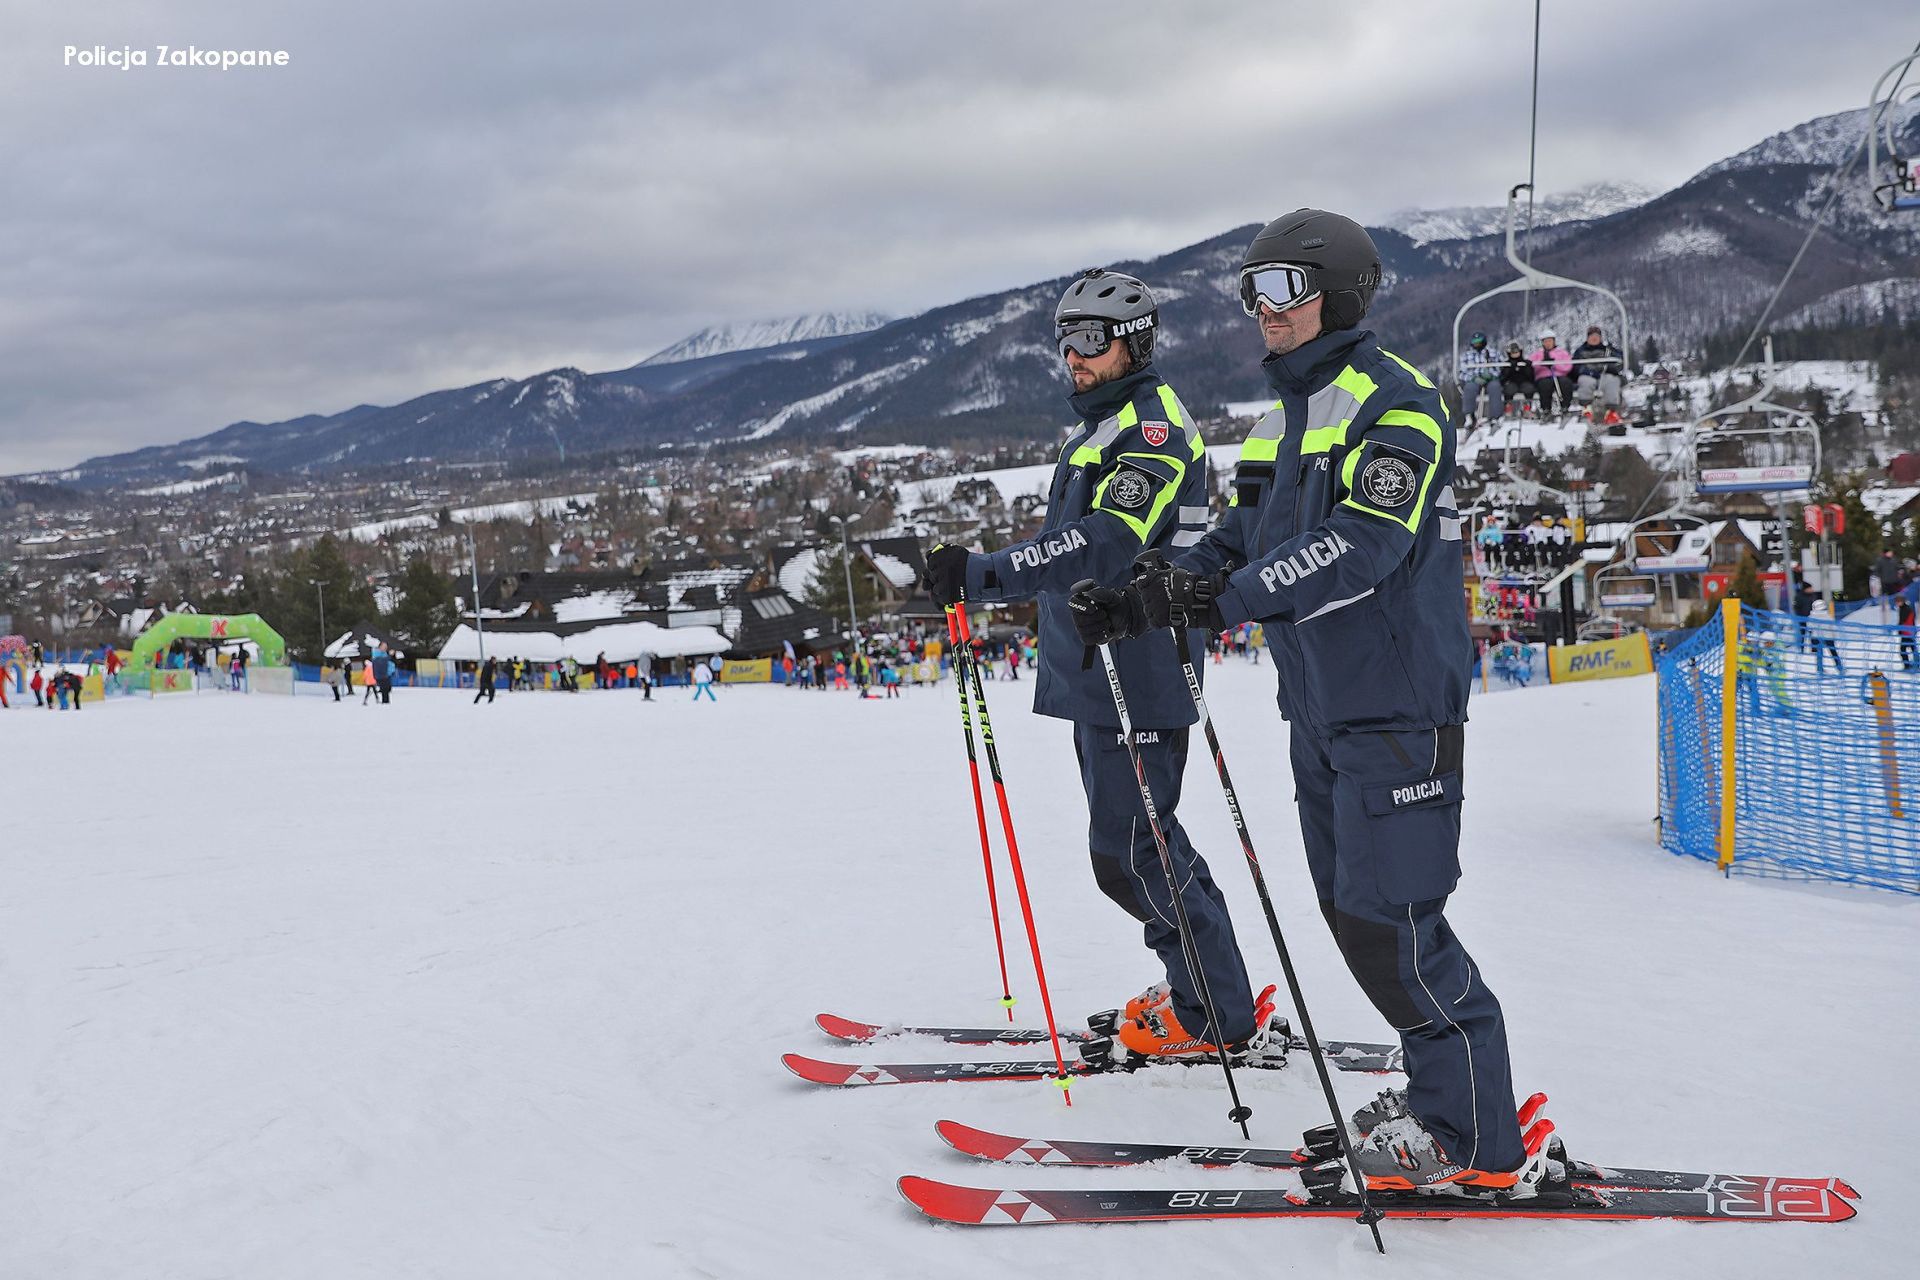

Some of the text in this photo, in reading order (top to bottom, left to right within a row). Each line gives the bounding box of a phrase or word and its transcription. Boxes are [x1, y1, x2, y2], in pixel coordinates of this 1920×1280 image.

[1301, 238, 1323, 246] uvex
[1112, 314, 1153, 337] uvex
[1147, 429, 1165, 441] PZN
[1009, 528, 1088, 572] POLICJA
[1259, 530, 1355, 593] POLICJA
[1569, 648, 1616, 673] RMF
[1108, 668, 1129, 719] GABEL
[960, 692, 972, 730] LEKI
[975, 699, 994, 744] LEKI
[1116, 731, 1160, 745] PICJA
[1141, 785, 1157, 819] SPEED
[1392, 780, 1444, 805] POLICJA
[1224, 788, 1243, 829] SPEED
[1182, 1147, 1250, 1160] F18
[1168, 1191, 1243, 1208] F18
